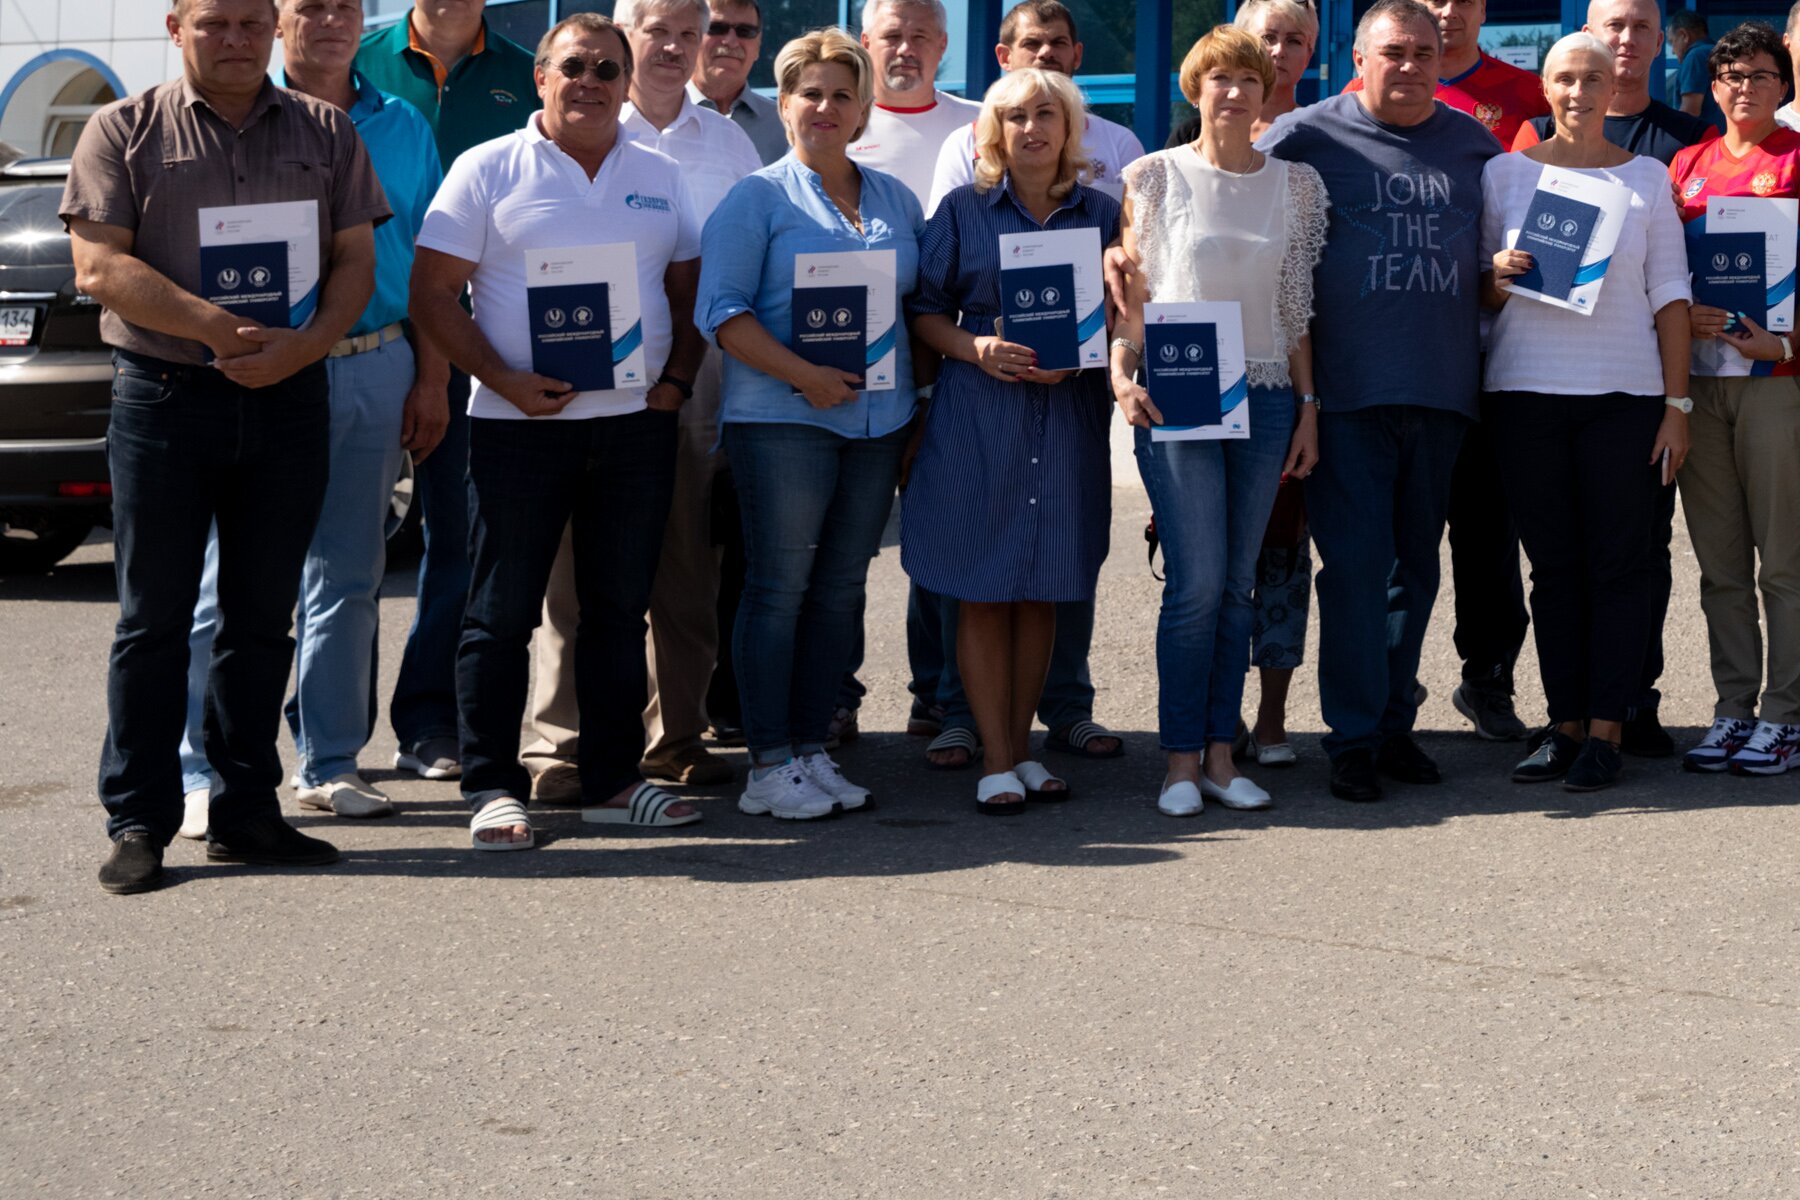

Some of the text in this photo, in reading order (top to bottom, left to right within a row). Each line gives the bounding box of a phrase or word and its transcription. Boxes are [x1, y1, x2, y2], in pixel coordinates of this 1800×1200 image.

[1371, 171, 1450, 212] JOIN
[1386, 212, 1441, 250] THE
[1367, 253, 1459, 296] TEAM
